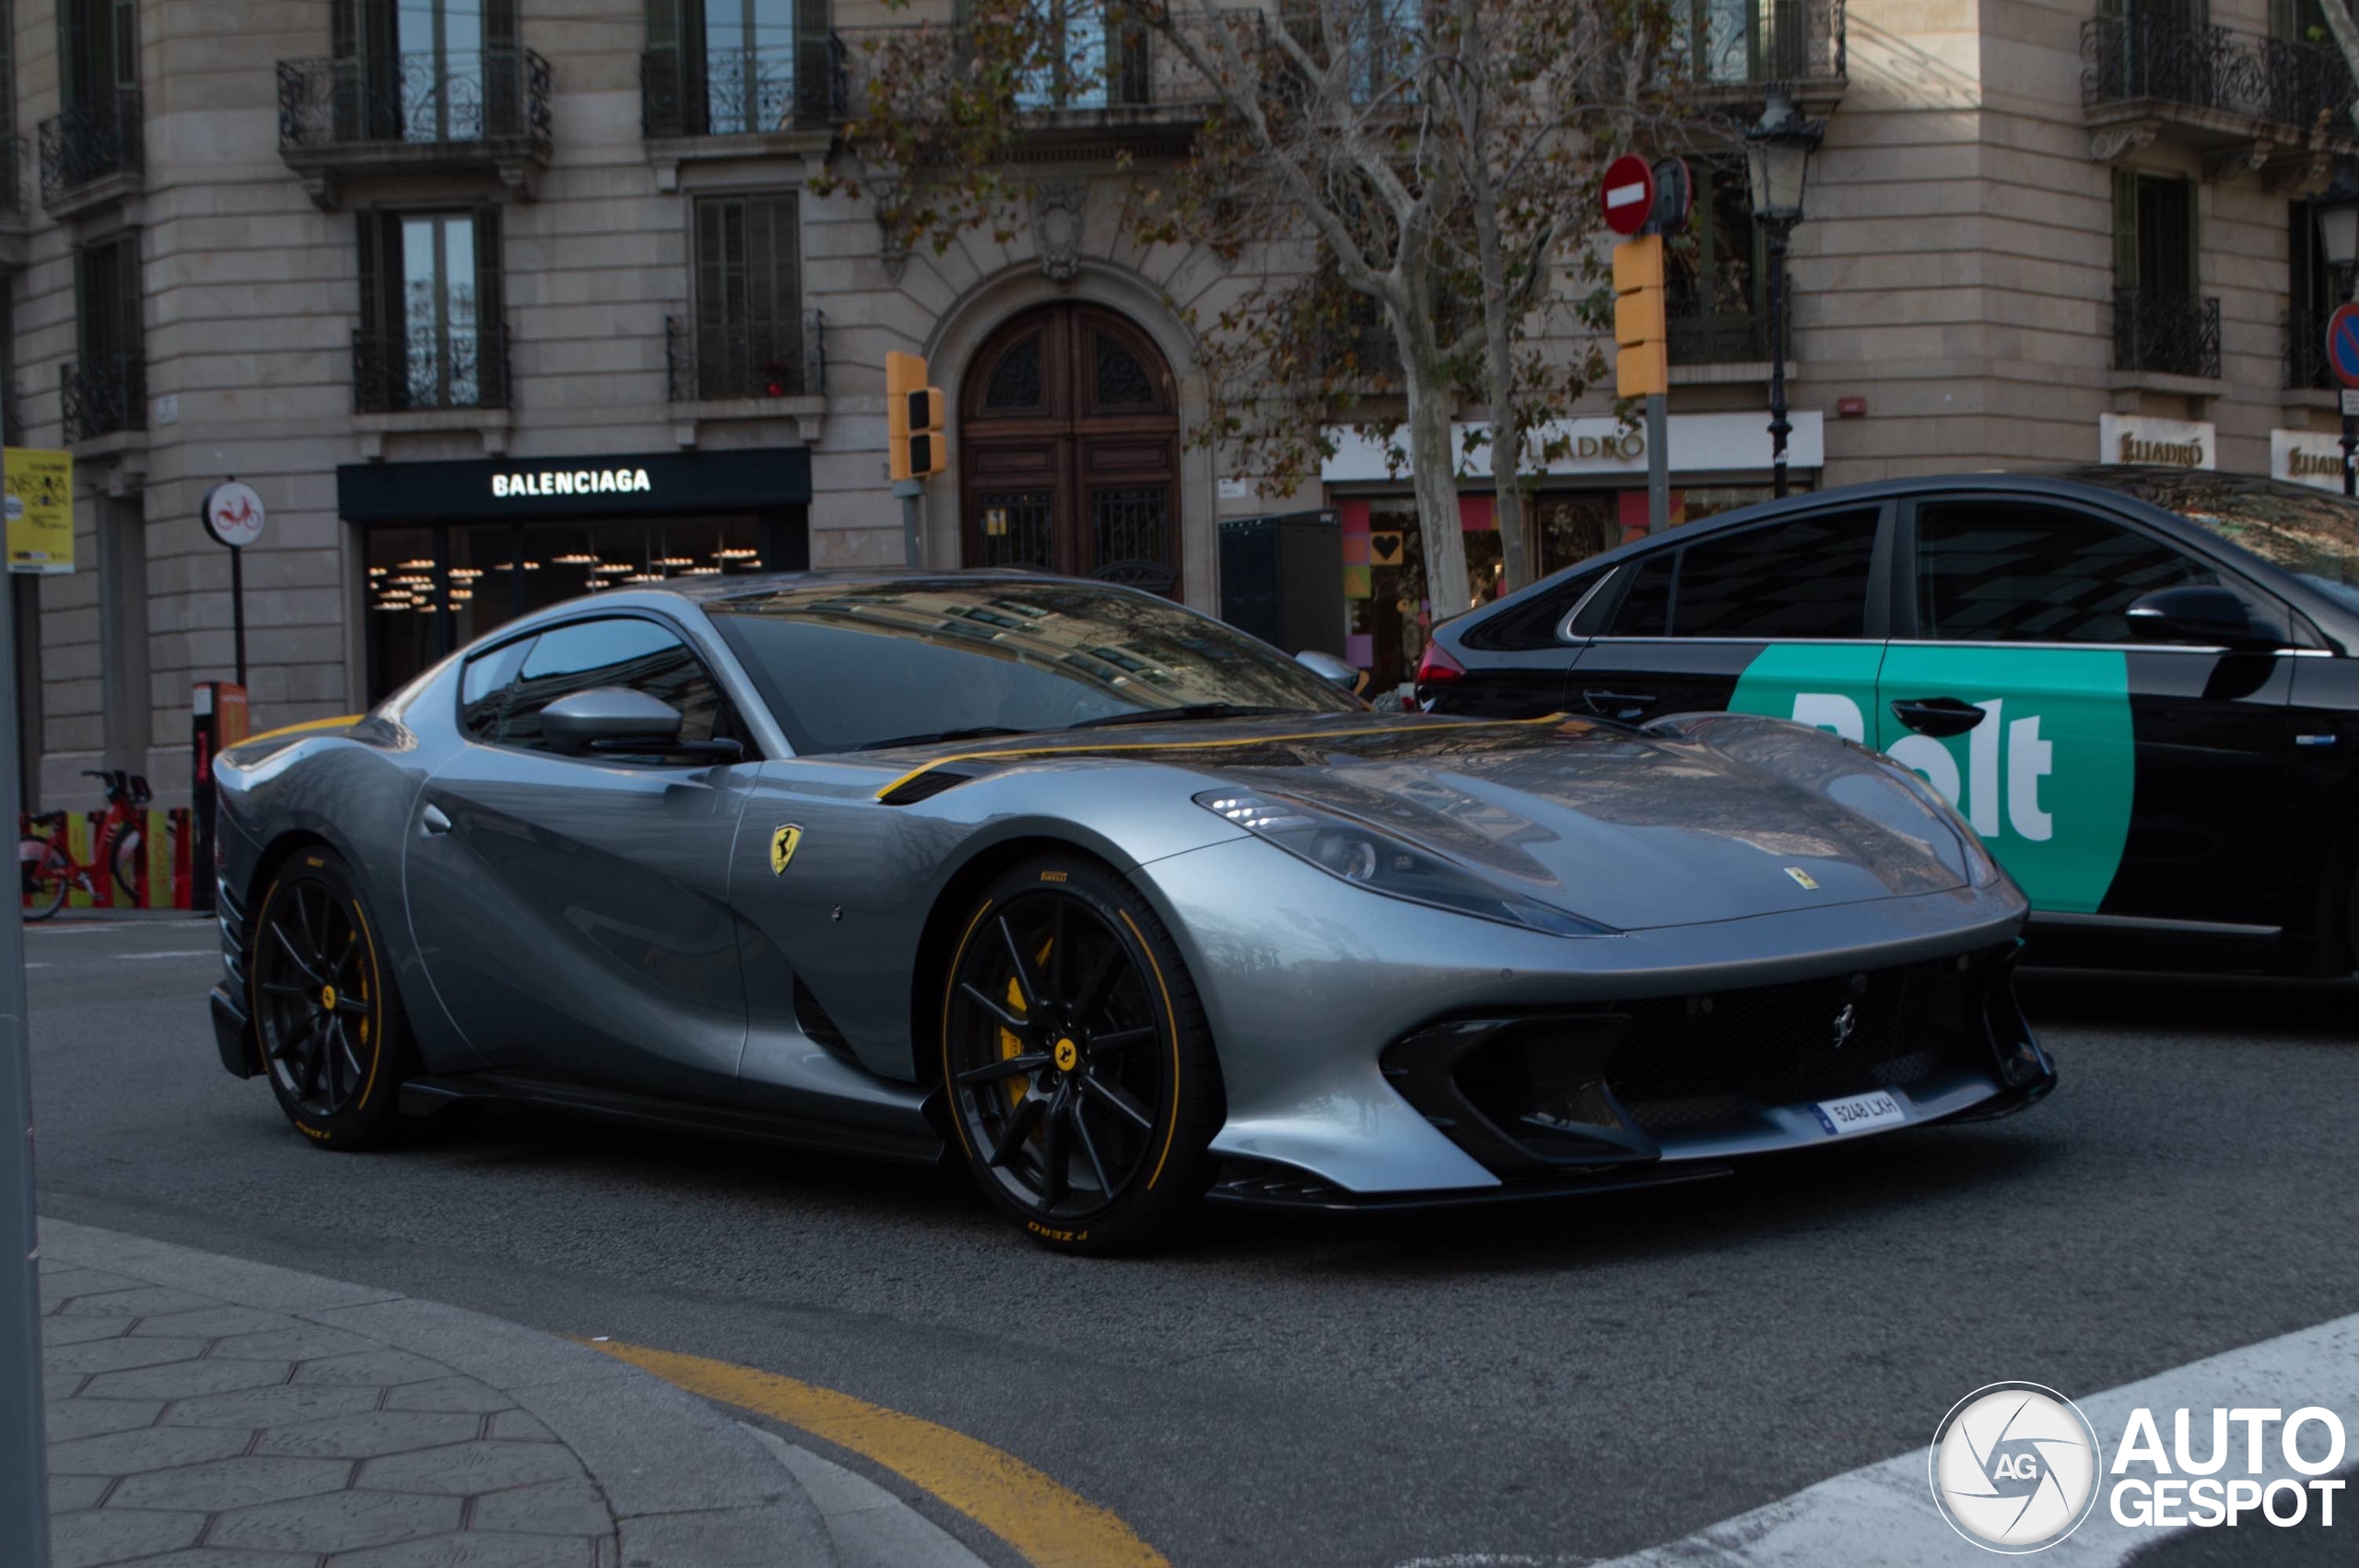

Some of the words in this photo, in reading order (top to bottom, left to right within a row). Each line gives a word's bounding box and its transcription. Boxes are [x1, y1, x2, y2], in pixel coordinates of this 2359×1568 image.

[492, 469, 651, 497] BALENCIAGA
[1834, 1102, 1869, 1122] 5248
[1864, 1097, 1898, 1116] LXH
